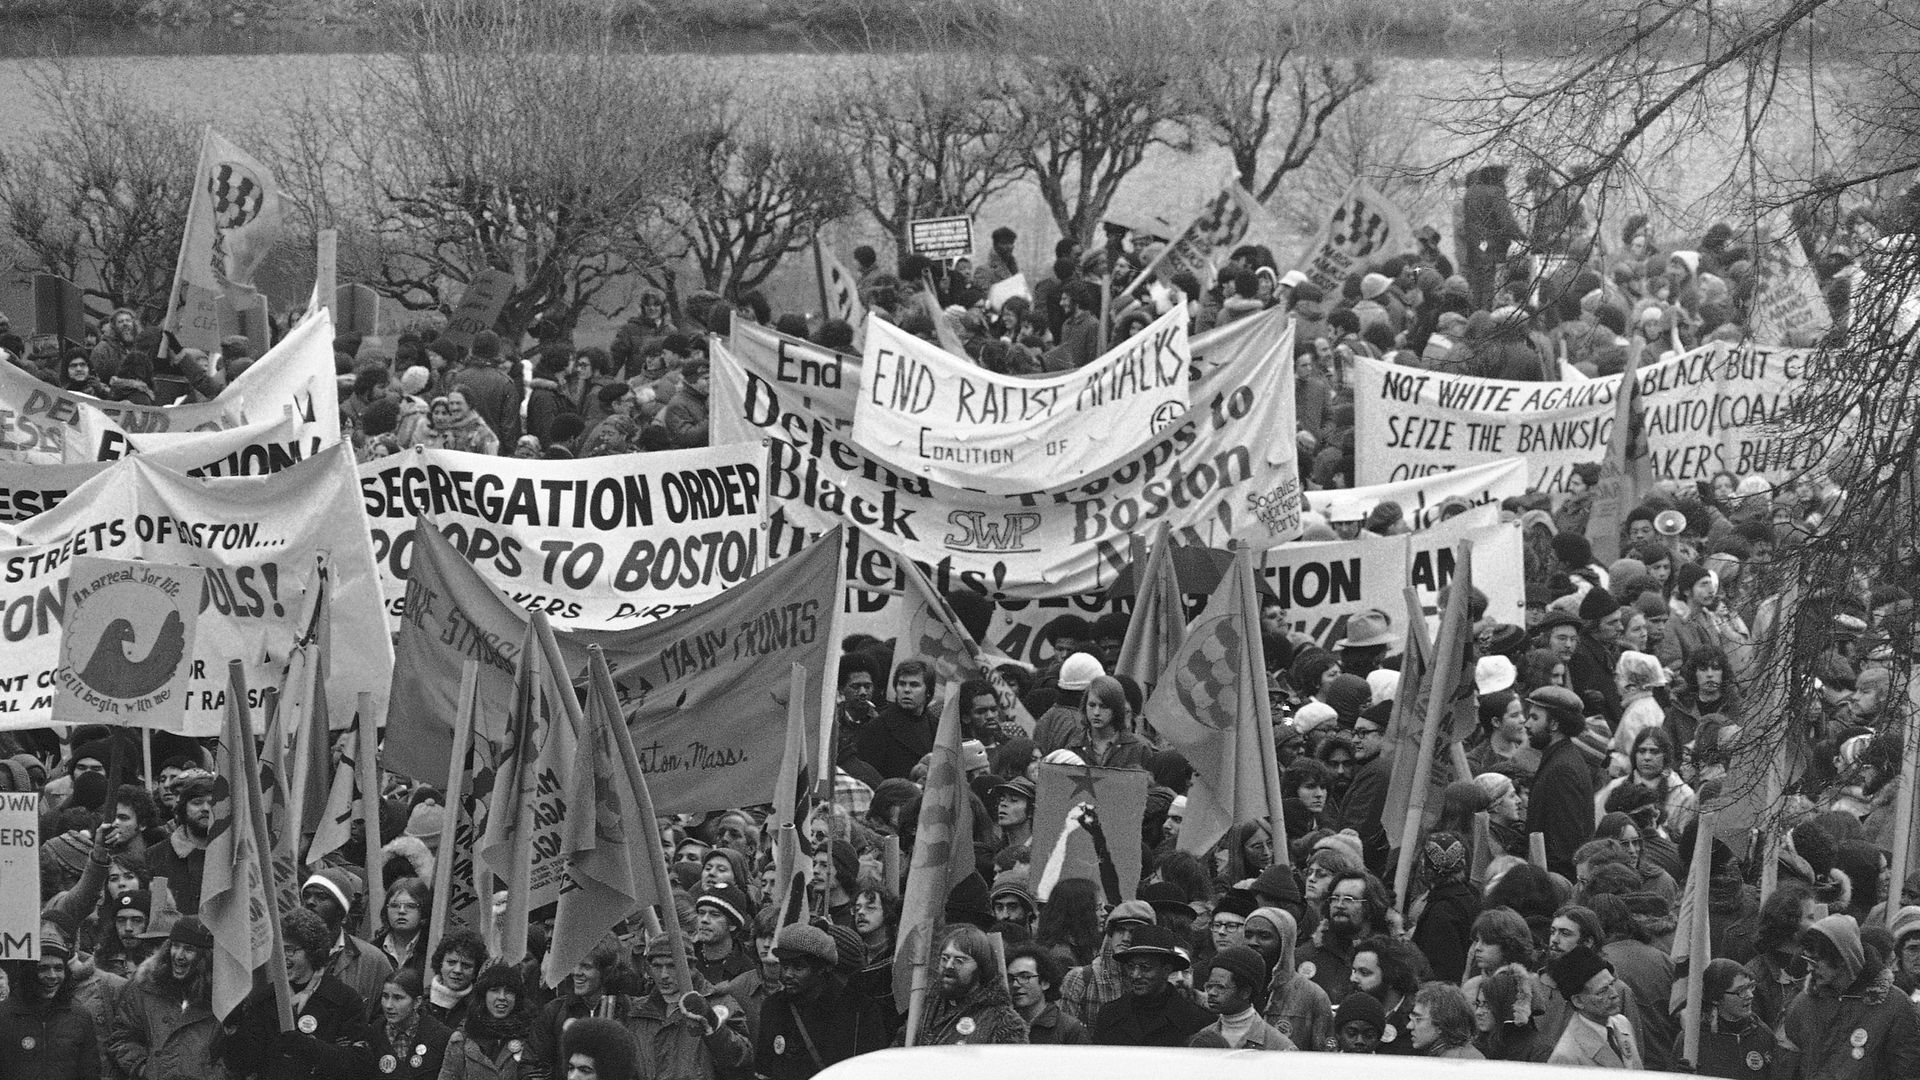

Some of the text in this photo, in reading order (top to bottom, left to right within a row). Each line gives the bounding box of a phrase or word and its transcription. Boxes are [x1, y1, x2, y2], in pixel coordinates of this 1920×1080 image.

[776, 339, 843, 390] End
[871, 348, 936, 415] END
[956, 376, 1065, 425] RACIST
[1641, 349, 1715, 396] BLACK
[1724, 350, 1775, 381] BUT
[1210, 384, 1254, 430] to
[1381, 370, 1616, 412] NOT WHITE AGAINS
[919, 426, 1068, 463] COALITION OF
[1386, 415, 1456, 451] SEIZE
[1467, 422, 1506, 453] THE
[1649, 443, 1725, 480] AKERS
[661, 462, 760, 524] ORDER
[769, 436, 1255, 546] Black Boston
[5, 518, 126, 583] STREETS
[134, 514, 172, 544] OF
[945, 509, 1042, 550] SWP
[160, 577, 180, 597] life
[539, 539, 604, 591] TO
[83, 690, 119, 714] begin
[125, 699, 153, 713] with
[153, 689, 171, 705] me
